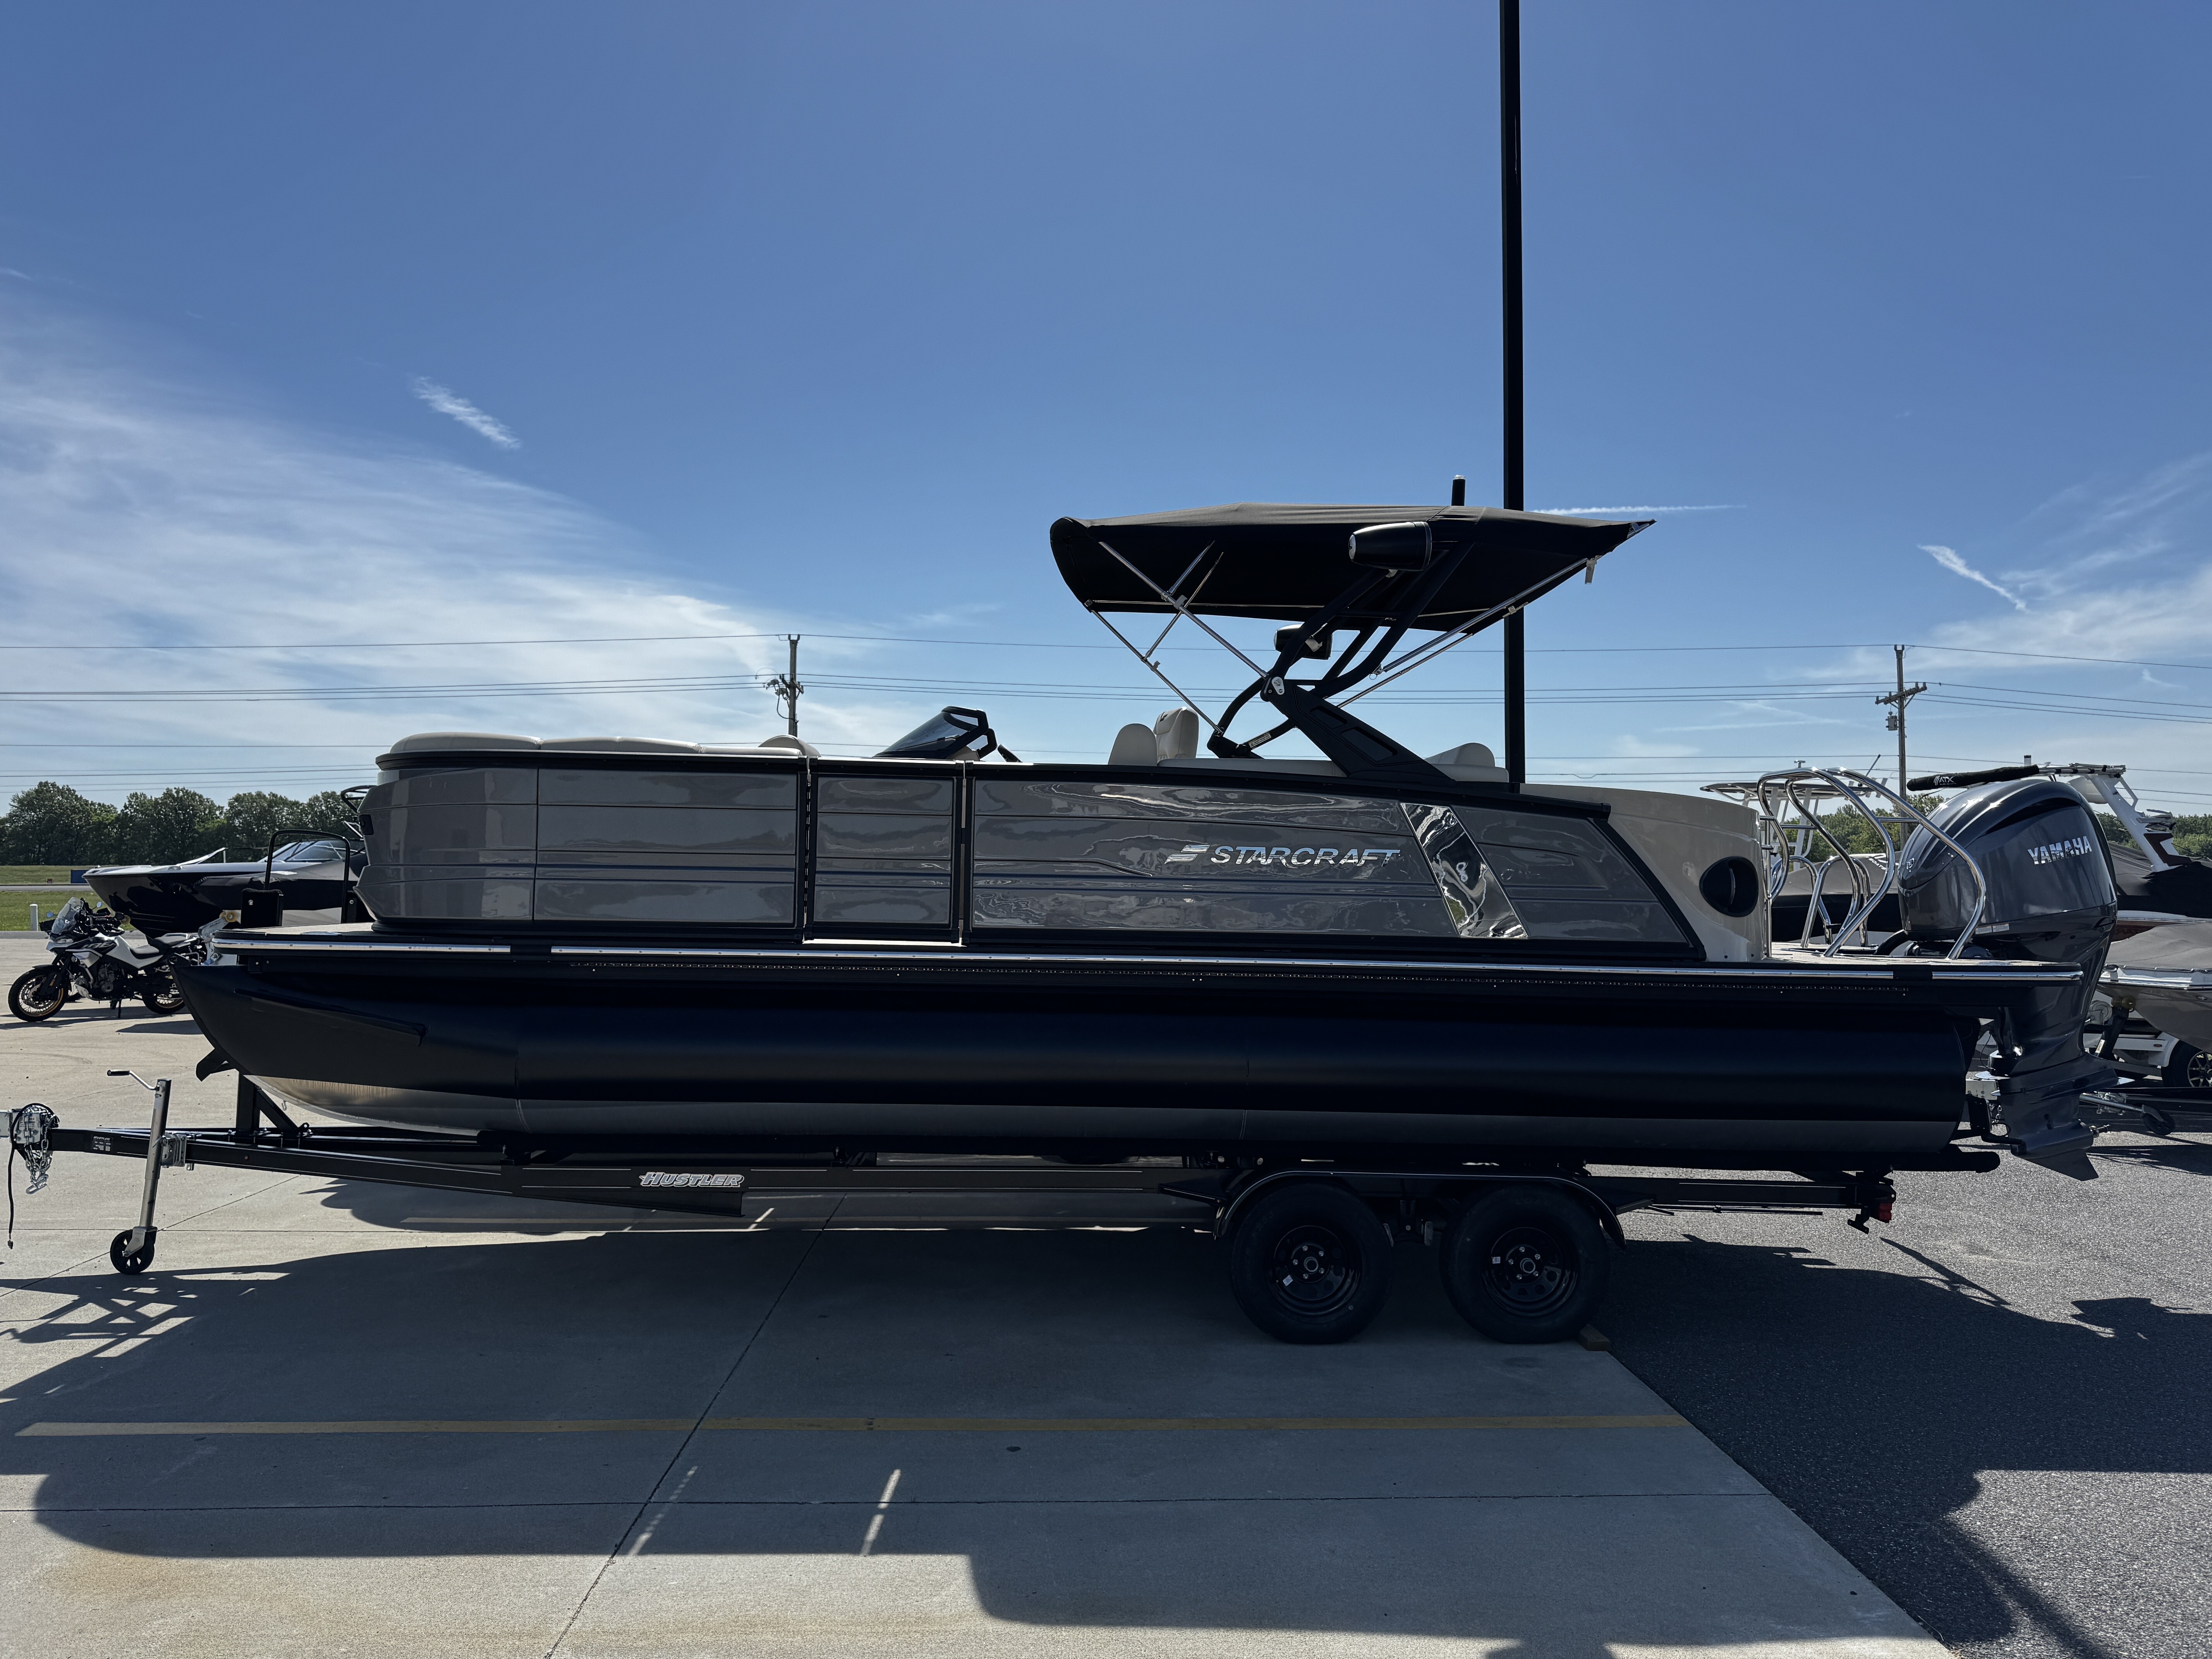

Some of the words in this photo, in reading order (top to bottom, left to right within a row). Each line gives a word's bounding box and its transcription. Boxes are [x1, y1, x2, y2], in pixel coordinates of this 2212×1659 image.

[1211, 846, 1400, 869] STARCRAFT
[2027, 836, 2092, 865] YAMAHA
[639, 1172, 744, 1187] HUSTLER
